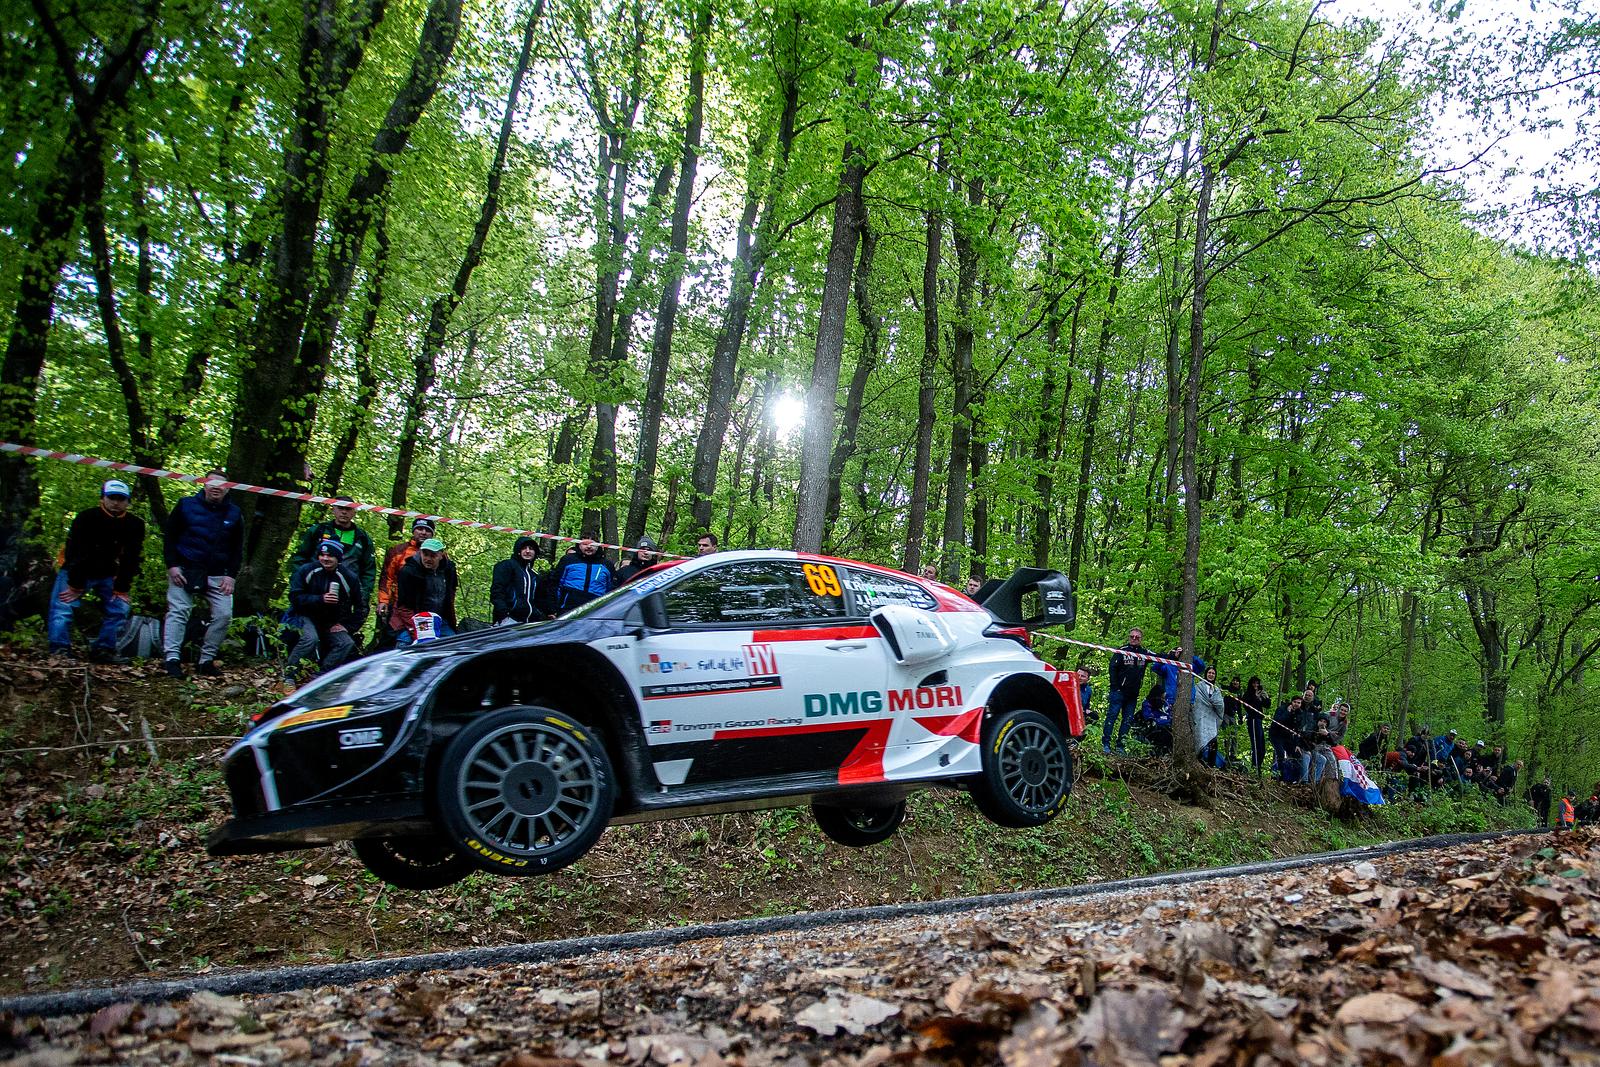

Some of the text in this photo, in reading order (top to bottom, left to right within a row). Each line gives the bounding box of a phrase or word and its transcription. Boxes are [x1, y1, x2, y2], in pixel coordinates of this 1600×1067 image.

[802, 563, 842, 597] 69
[804, 685, 963, 718] DMG MORI
[675, 722, 722, 732] TOYOTA
[767, 717, 803, 727] Racing
[339, 730, 384, 746] OMP
